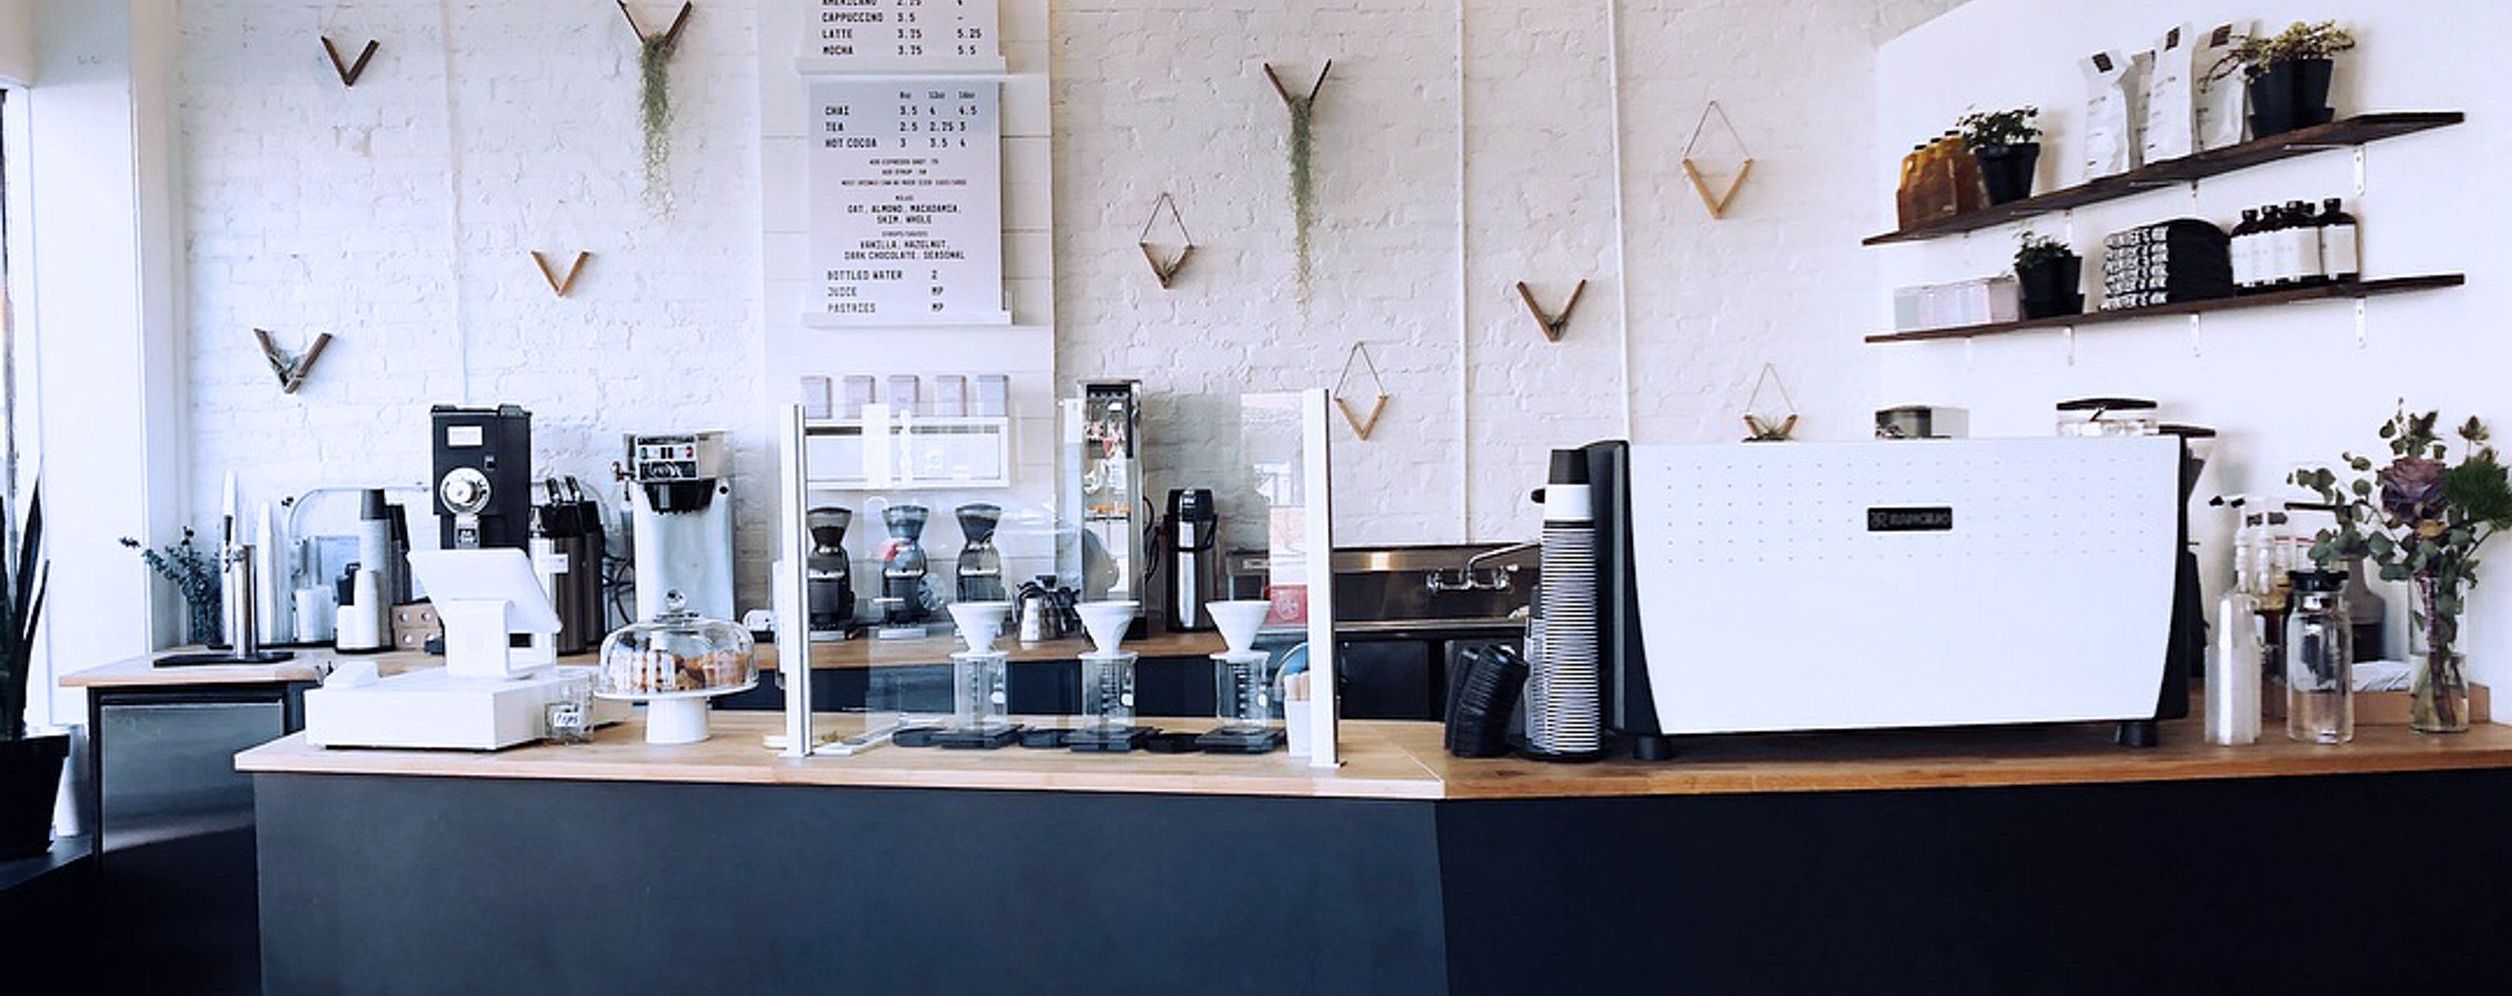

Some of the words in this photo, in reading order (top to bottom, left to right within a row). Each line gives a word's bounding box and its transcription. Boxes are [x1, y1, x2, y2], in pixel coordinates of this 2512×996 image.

[821, 12, 884, 23] CAPPUCCINO
[897, 12, 916, 23] 3.5
[821, 28, 853, 39] LATTE
[897, 28, 922, 39] 3.75
[956, 28, 982, 39] 5.25
[822, 45, 854, 56] MOCHA
[897, 45, 923, 56] 3.75
[957, 45, 977, 56] 5.5
[825, 105, 850, 116] CHAI
[899, 105, 918, 116] 3.5
[929, 105, 937, 116] 4
[958, 105, 978, 116] 4.5
[825, 121, 845, 132] TEA
[899, 121, 918, 132] 2.5
[929, 121, 954, 132] 2.75
[959, 121, 967, 132] 3
[825, 138, 844, 149] HOT
[846, 138, 878, 149] COCOA
[899, 138, 907, 149] 3
[929, 138, 948, 149] 3.5
[959, 138, 967, 149] 4
[847, 204, 868, 215] OAT,
[871, 204, 908, 215] ALMOND,
[910, 204, 962, 215] MACADAMIA,
[905, 215, 932, 225] WHOLE
[844, 250, 866, 260] DARK
[923, 250, 965, 260] SEASONAL
[827, 269, 870, 281] BOTTLED
[873, 269, 903, 281] WATER
[931, 269, 938, 281] 2
[827, 286, 858, 297] JUICE
[931, 286, 944, 297] MP
[827, 302, 876, 314] PASTRIES
[931, 302, 944, 314] MP
